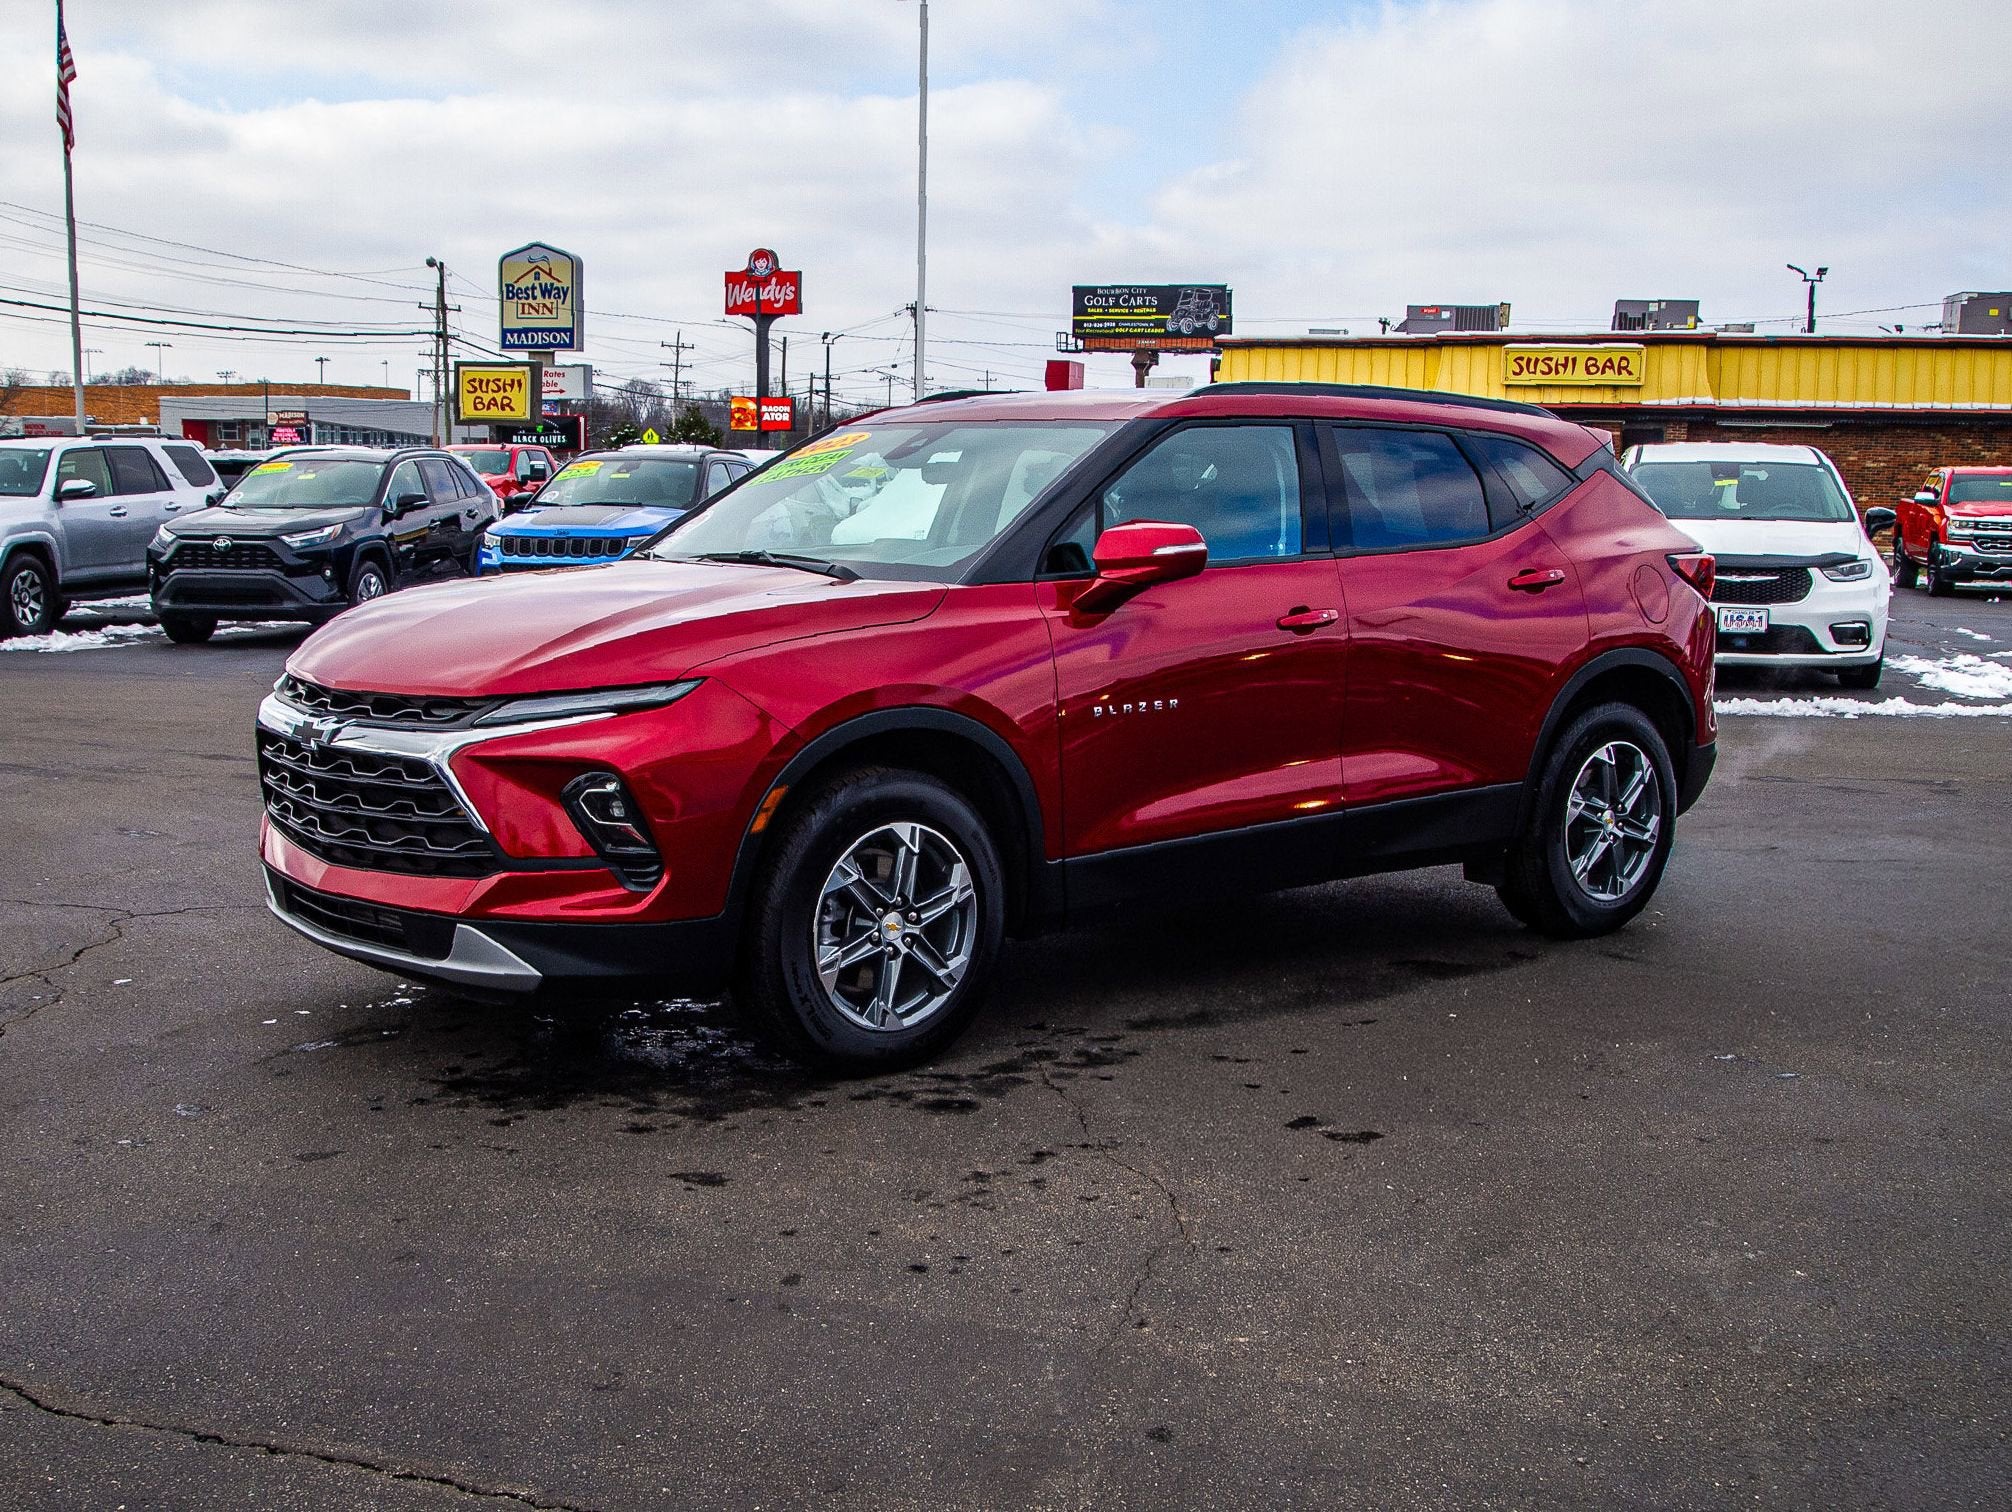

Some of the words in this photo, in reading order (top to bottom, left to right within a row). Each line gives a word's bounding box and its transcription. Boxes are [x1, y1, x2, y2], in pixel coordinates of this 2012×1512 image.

[505, 283, 537, 300] Best
[539, 282, 570, 305] Way
[1084, 295, 1116, 306] GOLF
[1120, 295, 1158, 306] CARTS
[520, 301, 554, 315] INN
[505, 332, 571, 344] MADISON
[1511, 356, 1578, 376] SUSHI
[1584, 355, 1634, 376] BAR
[543, 370, 566, 378] Rates
[466, 377, 523, 394] SUSHI
[473, 395, 515, 412] BAR
[762, 412, 790, 421] ATOR
[512, 435, 537, 443] BLACK
[540, 434, 566, 444] OLIVES
[1093, 698, 1178, 718] BLAZER
